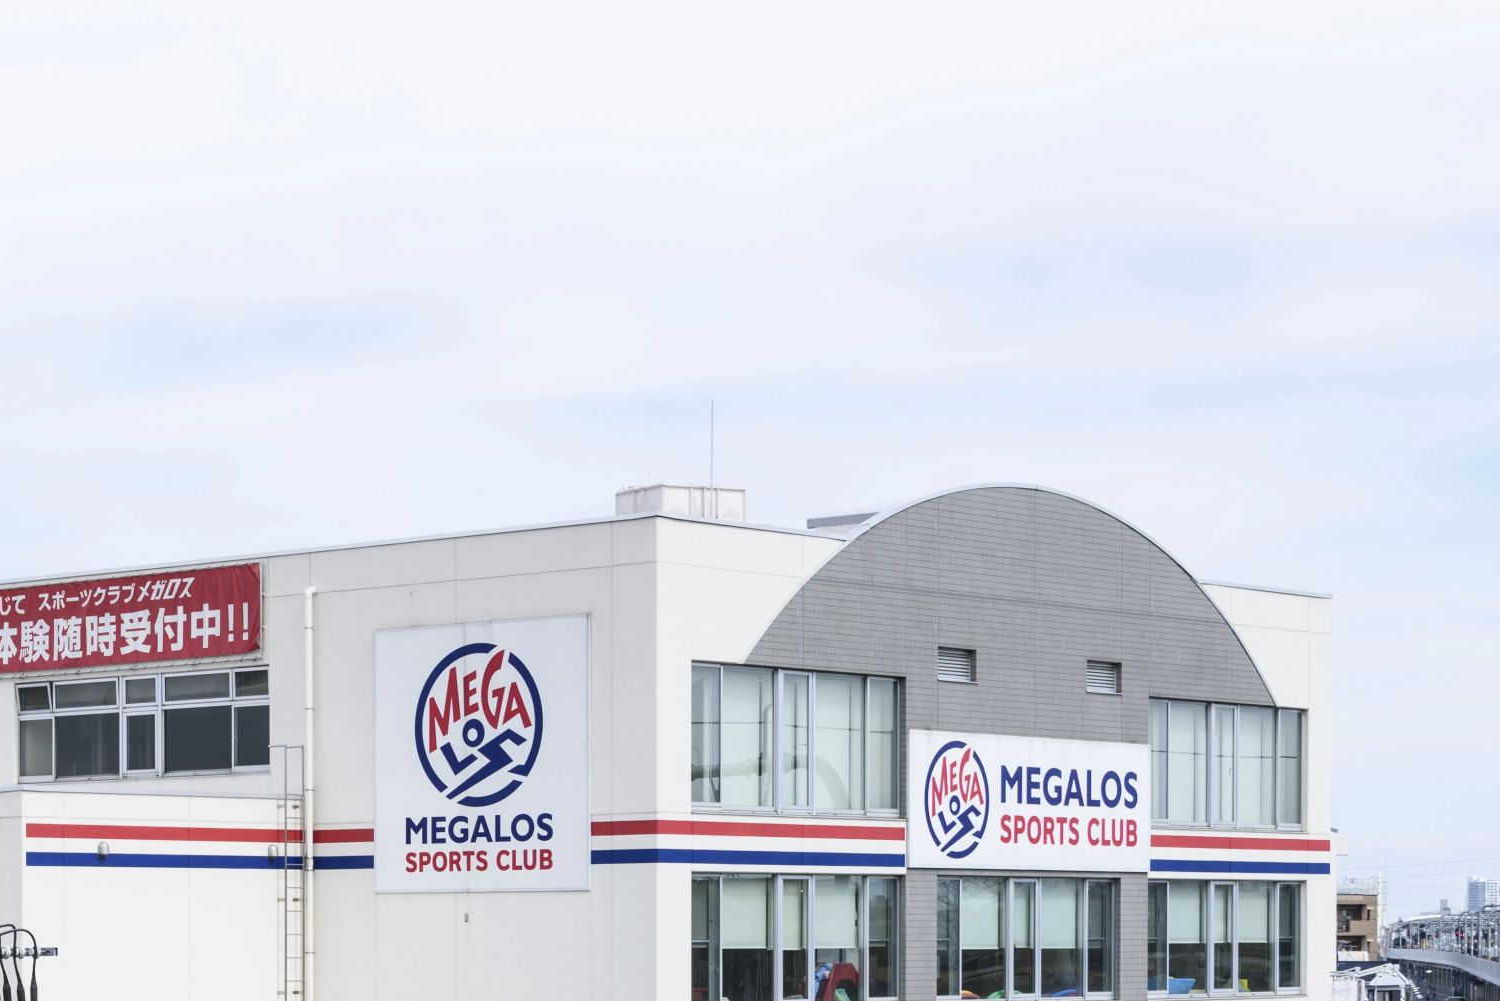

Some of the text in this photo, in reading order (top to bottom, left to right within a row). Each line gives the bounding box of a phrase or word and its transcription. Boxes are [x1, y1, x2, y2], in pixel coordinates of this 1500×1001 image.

[1000, 765, 1138, 809] MEGALOS
[405, 813, 554, 845] MEGALOS
[1000, 814, 1138, 847] SPORTS CLUB
[405, 849, 554, 873] SPORTS CLUB
